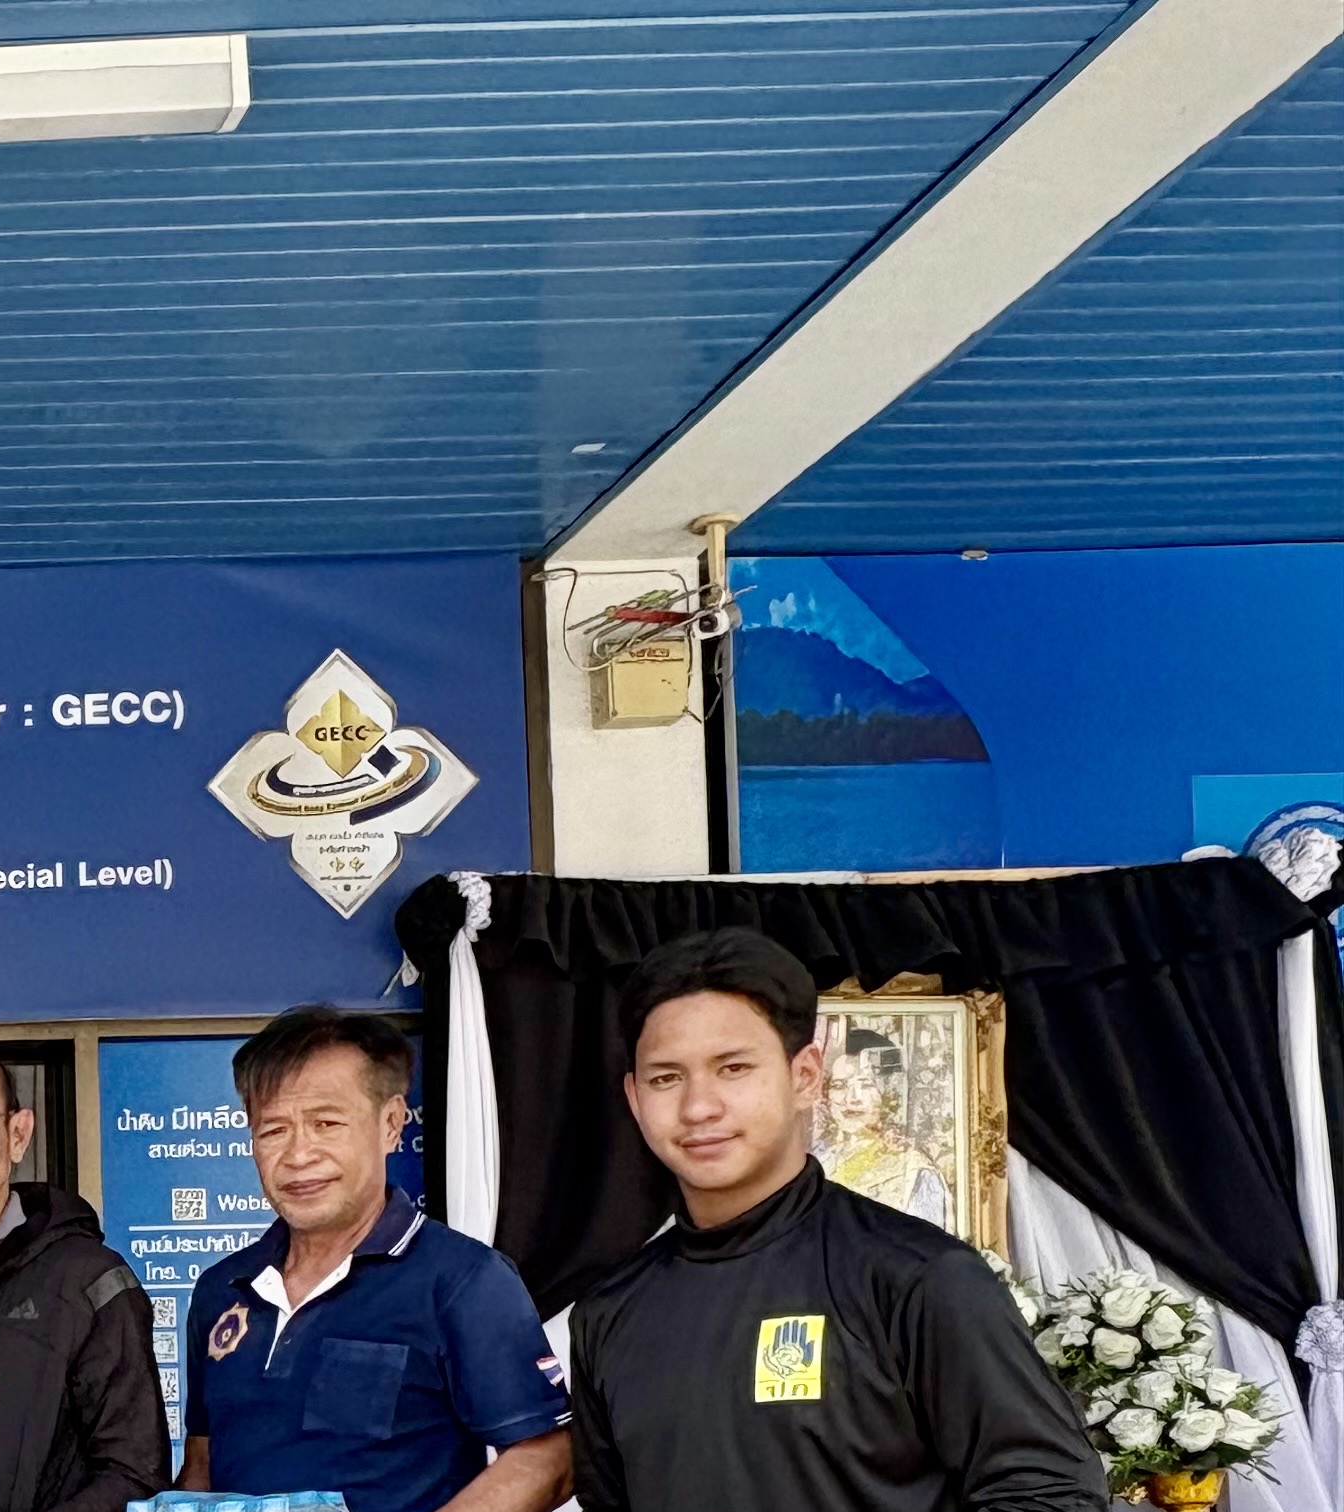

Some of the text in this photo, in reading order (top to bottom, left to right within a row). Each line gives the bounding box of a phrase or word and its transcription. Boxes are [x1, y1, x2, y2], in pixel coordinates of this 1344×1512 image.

[23, 703, 34, 727] :
[51, 689, 185, 730] GECC)
[314, 724, 370, 742] GECC
[78, 858, 173, 890] Level)
[172, 1104, 249, 1130] มีเหลือ
